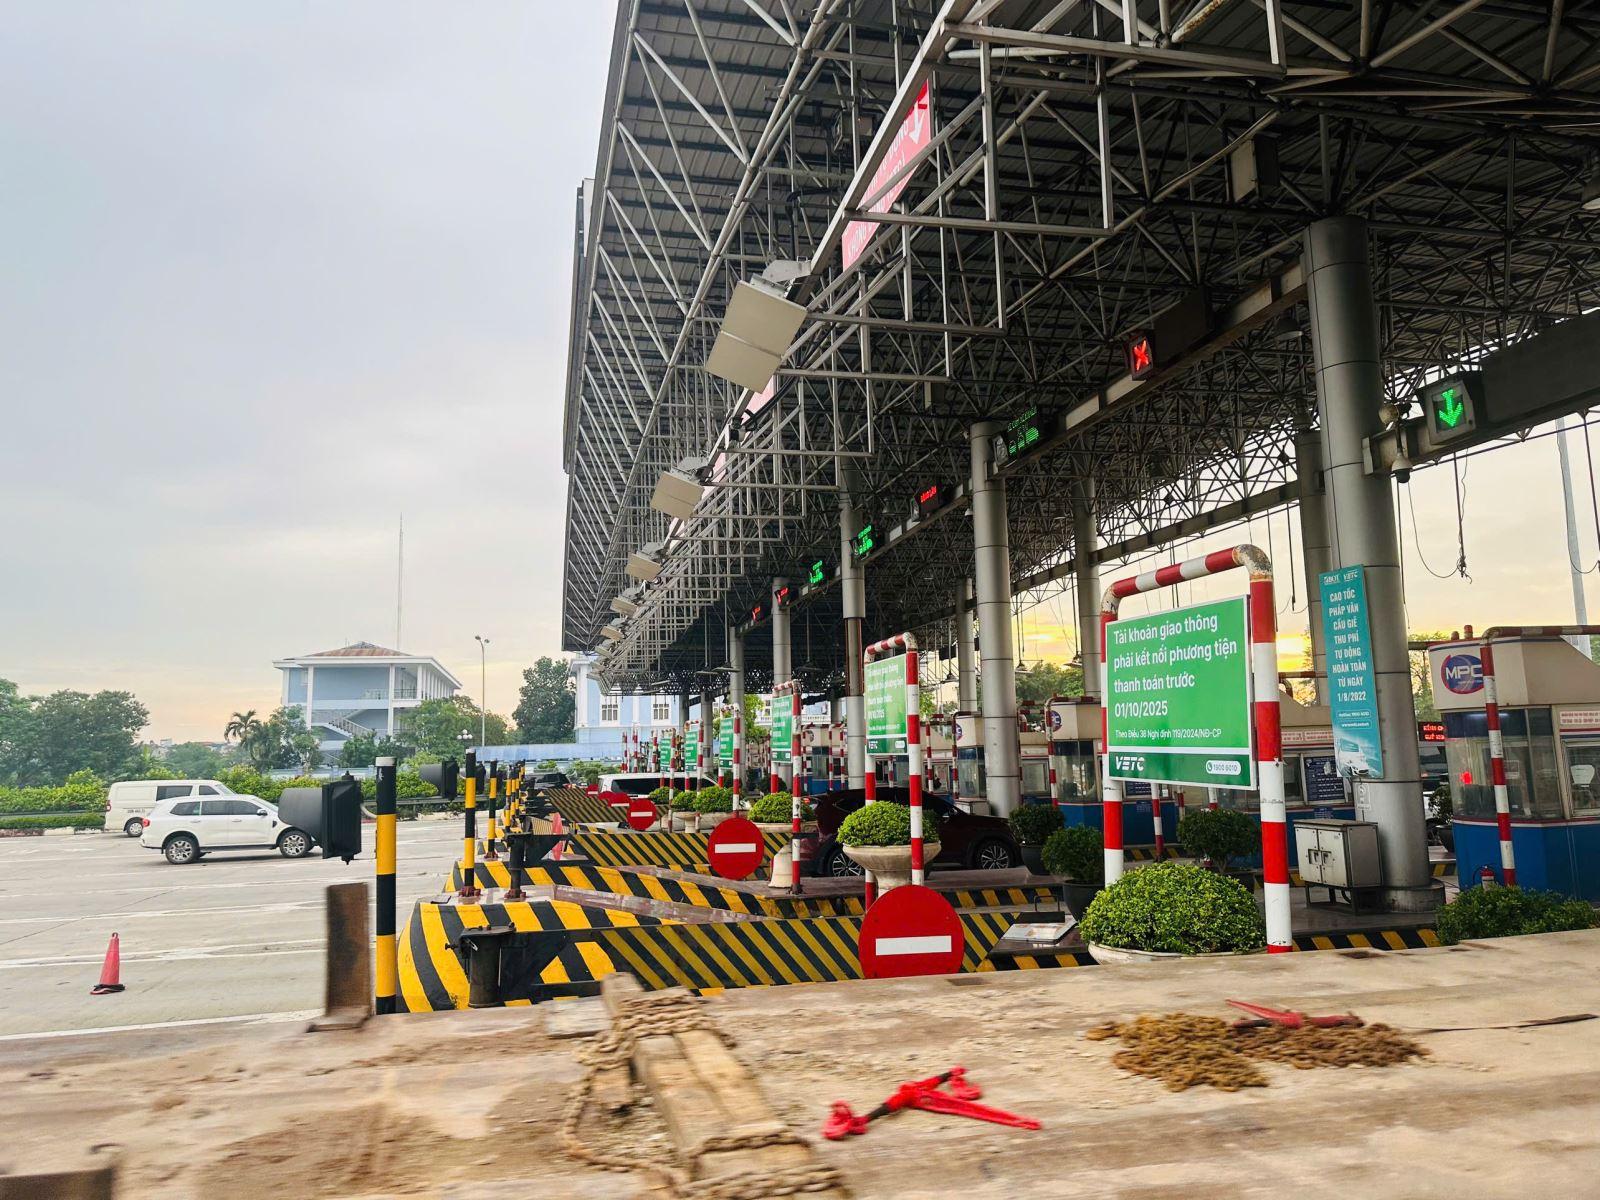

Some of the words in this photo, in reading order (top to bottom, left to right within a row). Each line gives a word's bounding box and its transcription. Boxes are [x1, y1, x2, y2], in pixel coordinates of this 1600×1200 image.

[1330, 592, 1342, 602] CAO
[1344, 587, 1355, 600] TỐC
[1329, 604, 1346, 617] PHÁP
[1114, 629, 1127, 644] Tài
[1129, 624, 1157, 642] khoản
[1160, 620, 1182, 640] giao
[1184, 614, 1218, 632] thông
[1334, 635, 1347, 644] THU
[1348, 630, 1359, 642] PHÍ
[1114, 652, 1133, 672] phải
[1136, 648, 1150, 665] kết
[1152, 644, 1167, 664] nối
[1170, 644, 1212, 666] phương
[1214, 638, 1237, 659] tiện
[1344, 647, 1361, 659] ĐỘNG
[1332, 662, 1349, 673] HOÀN
[1350, 660, 1367, 671] TOÀN
[1445, 664, 1483, 680] MPC
[1114, 678, 1140, 693] thanh
[1143, 674, 1164, 690] toán
[1166, 671, 1195, 688] trước
[1338, 691, 1366, 702] 1/8/2022
[1114, 700, 1168, 719] 01/10/2025
[1115, 730, 1127, 738] Theo
[1148, 730, 1160, 740] Nghị
[1160, 728, 1172, 740] định
[1115, 756, 1145, 771] VETC
